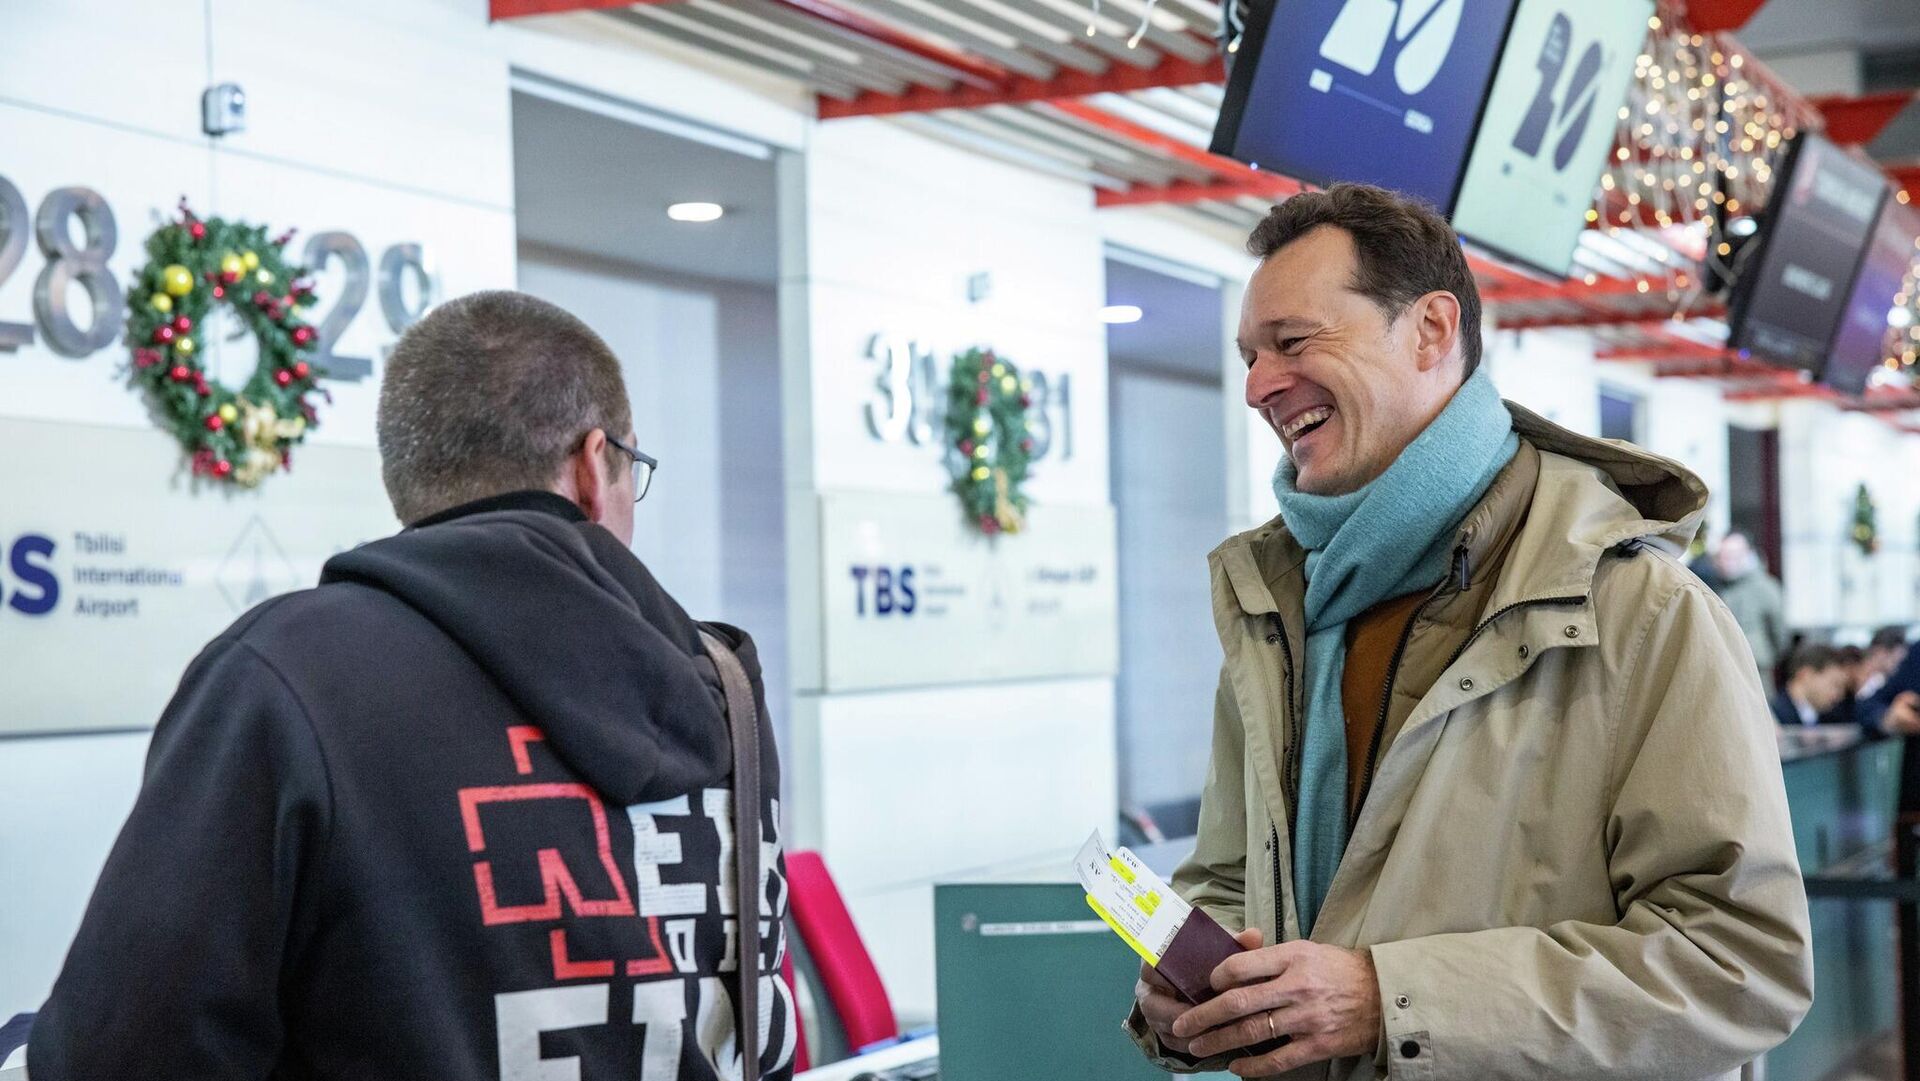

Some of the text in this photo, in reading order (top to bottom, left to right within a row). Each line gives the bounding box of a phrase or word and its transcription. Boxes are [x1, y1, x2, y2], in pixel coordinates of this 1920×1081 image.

[74, 533, 125, 553] Tbilisi
[74, 567, 183, 585] International
[850, 566, 916, 616] TBS
[75, 599, 139, 617] Airport
